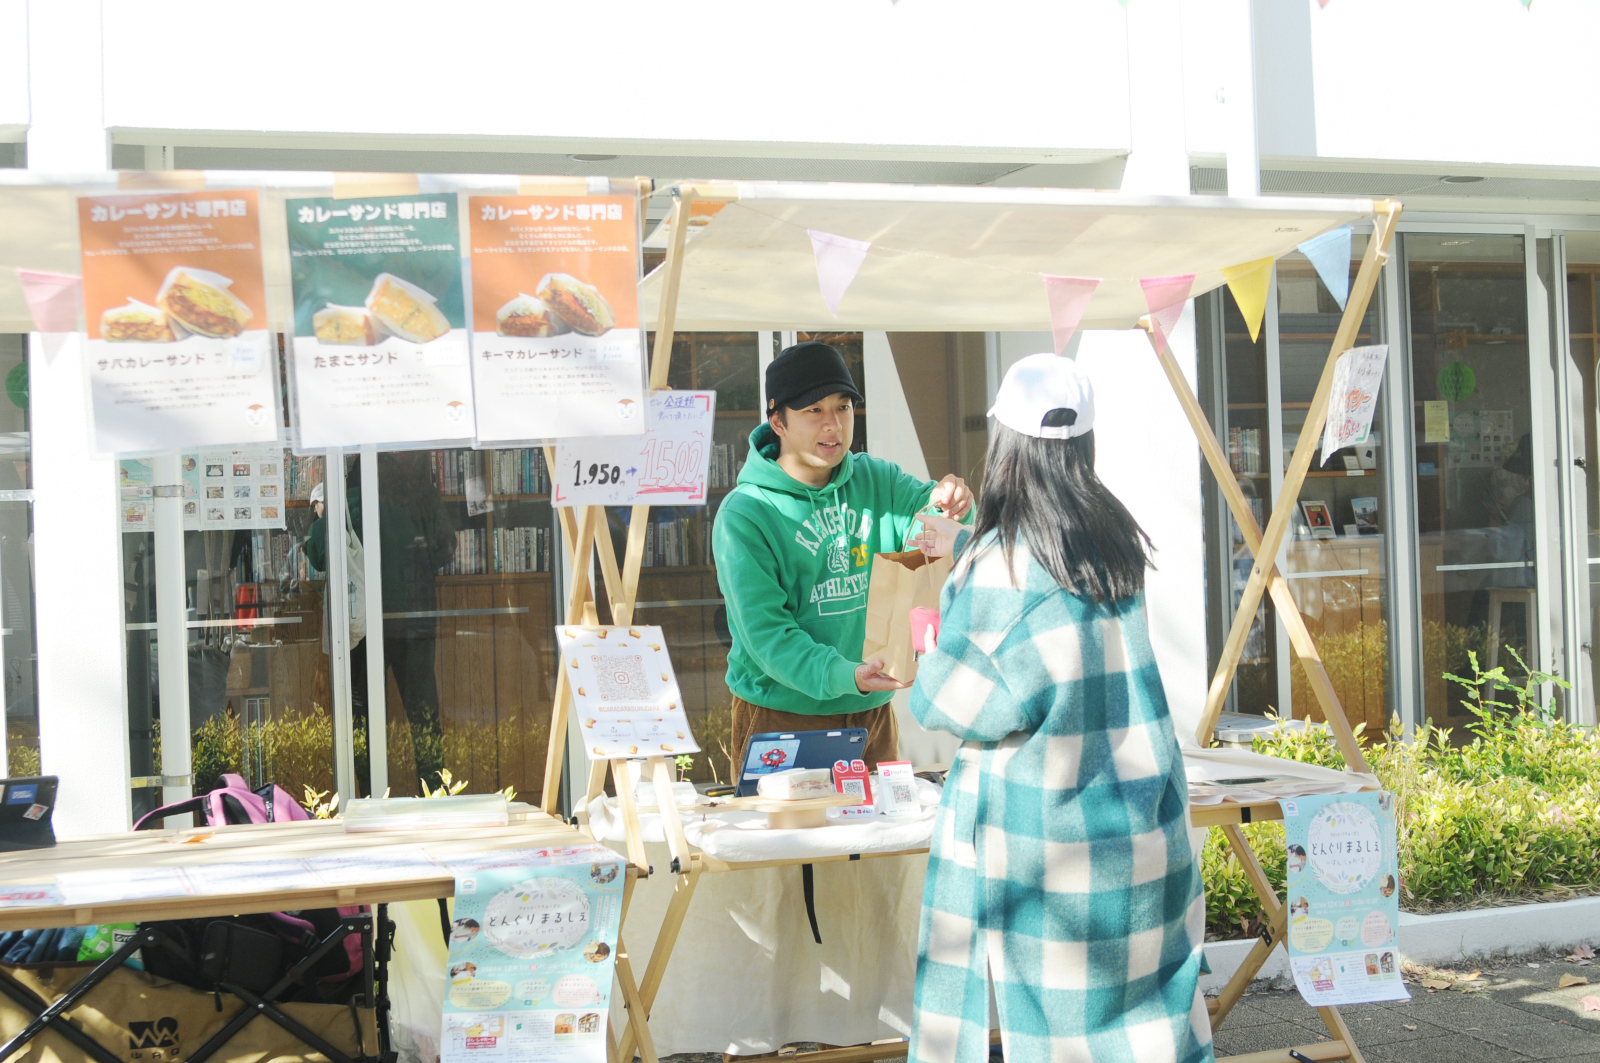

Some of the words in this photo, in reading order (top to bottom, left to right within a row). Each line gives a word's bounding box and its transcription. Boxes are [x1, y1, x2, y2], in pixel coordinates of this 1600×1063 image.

[91, 199, 247, 222] カレーサンド専門店
[298, 201, 447, 223] カレーサンド専門店
[481, 204, 623, 221] カレーサンド専門店
[97, 353, 206, 371] サバカレーサンド
[314, 352, 398, 369] たまごサンド
[481, 347, 583, 361] キーマカレーサンド
[664, 394, 696, 407] 全種類
[810, 572, 868, 604] ATHLETICS
[1312, 840, 1380, 856] どんぐりまるしぇ
[489, 912, 587, 927] どんぐりまるしぇ
[131, 1048, 179, 1059] WAQ
